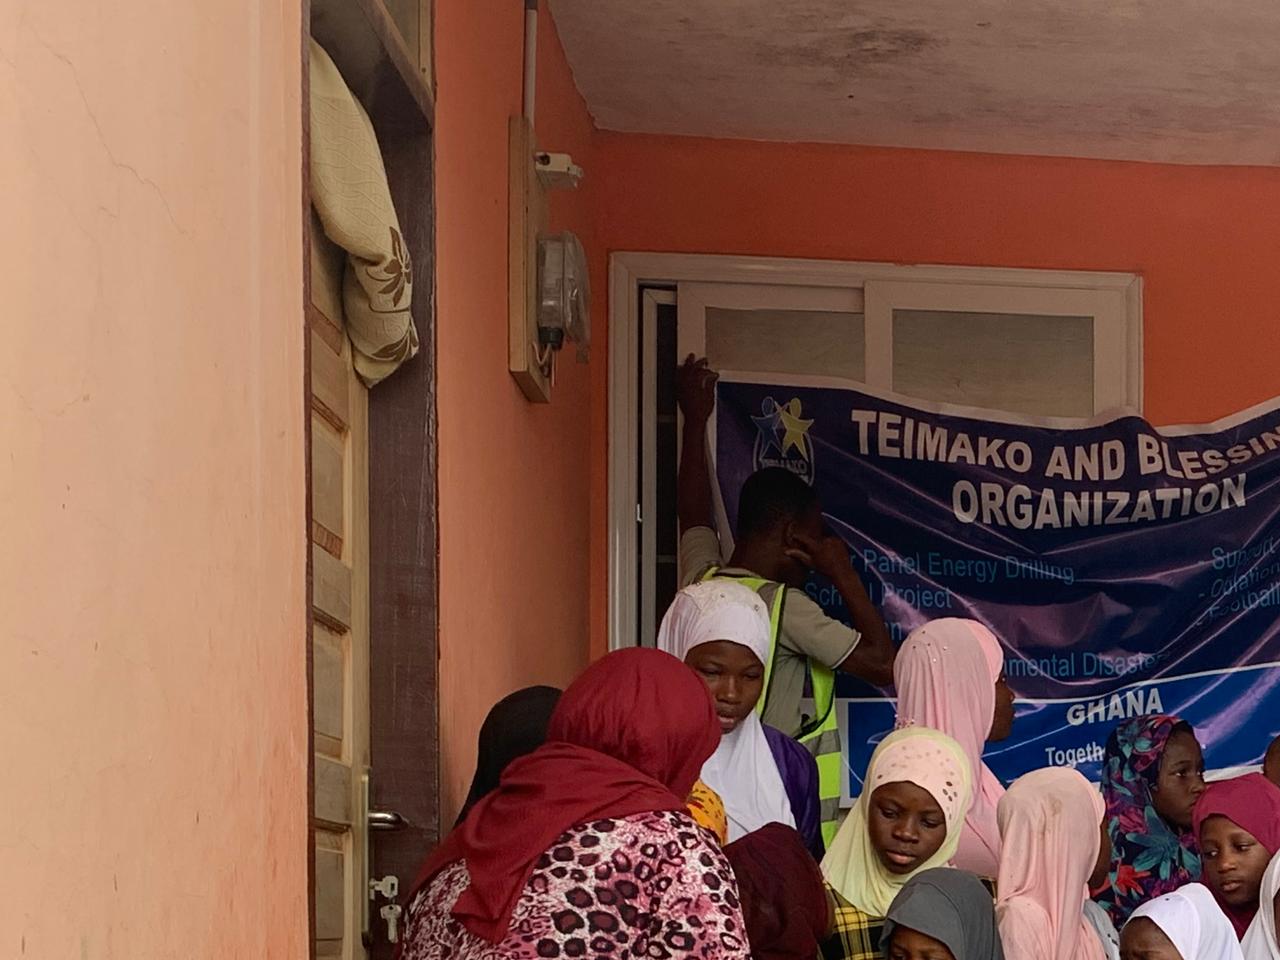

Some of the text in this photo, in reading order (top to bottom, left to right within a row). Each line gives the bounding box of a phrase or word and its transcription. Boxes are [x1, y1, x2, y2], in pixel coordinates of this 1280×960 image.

[851, 409, 1033, 473] TEIMAKO
[1045, 439, 1126, 481] AND
[952, 473, 1246, 530] ORGANIZATION
[863, 549, 921, 575] Panel
[928, 552, 998, 582] Energy
[1006, 555, 1074, 586] Drilling
[804, 582, 952, 611] Schl Project
[1066, 687, 1165, 726] GHANA
